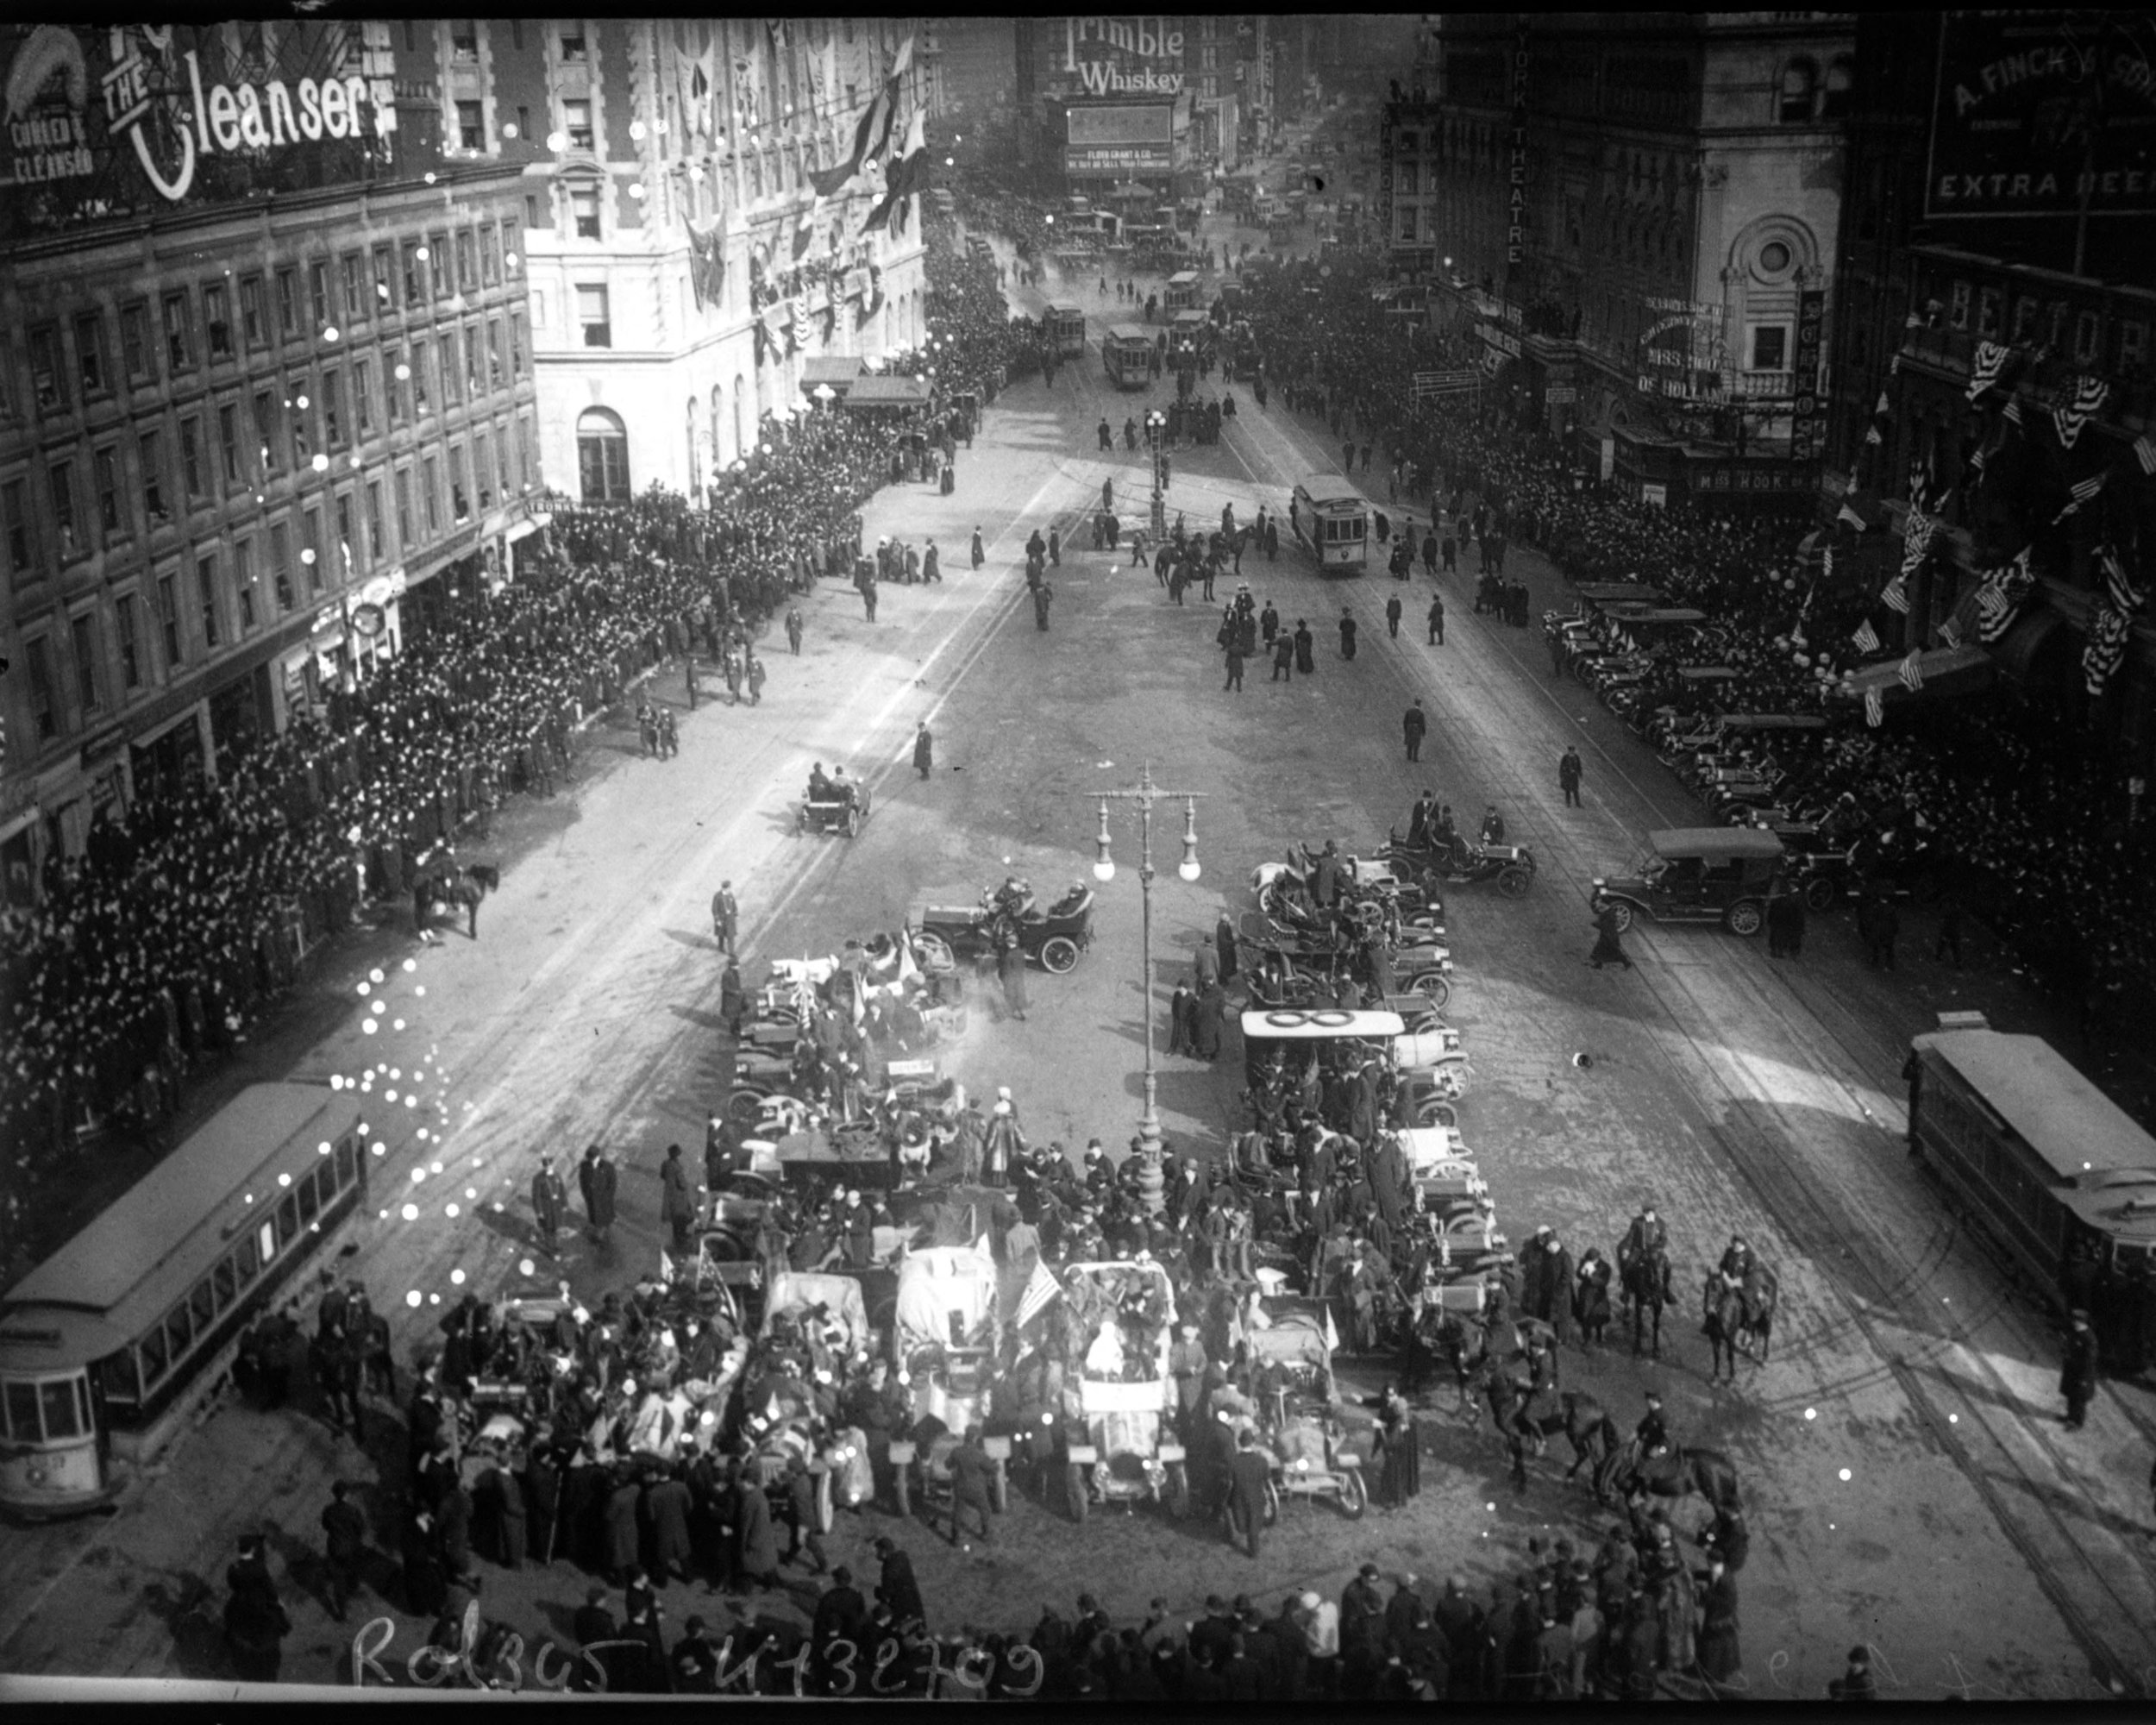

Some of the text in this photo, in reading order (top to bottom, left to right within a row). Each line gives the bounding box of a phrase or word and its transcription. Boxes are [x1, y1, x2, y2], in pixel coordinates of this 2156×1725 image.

[1079, 60, 1185, 97] Whiskey
[1980, 46, 2069, 94] FINCK
[103, 62, 148, 121] THE
[1508, 32, 1529, 263] YORK THEATRE
[1938, 173, 2059, 198] EXTRA
[1638, 374, 1658, 393] OF
